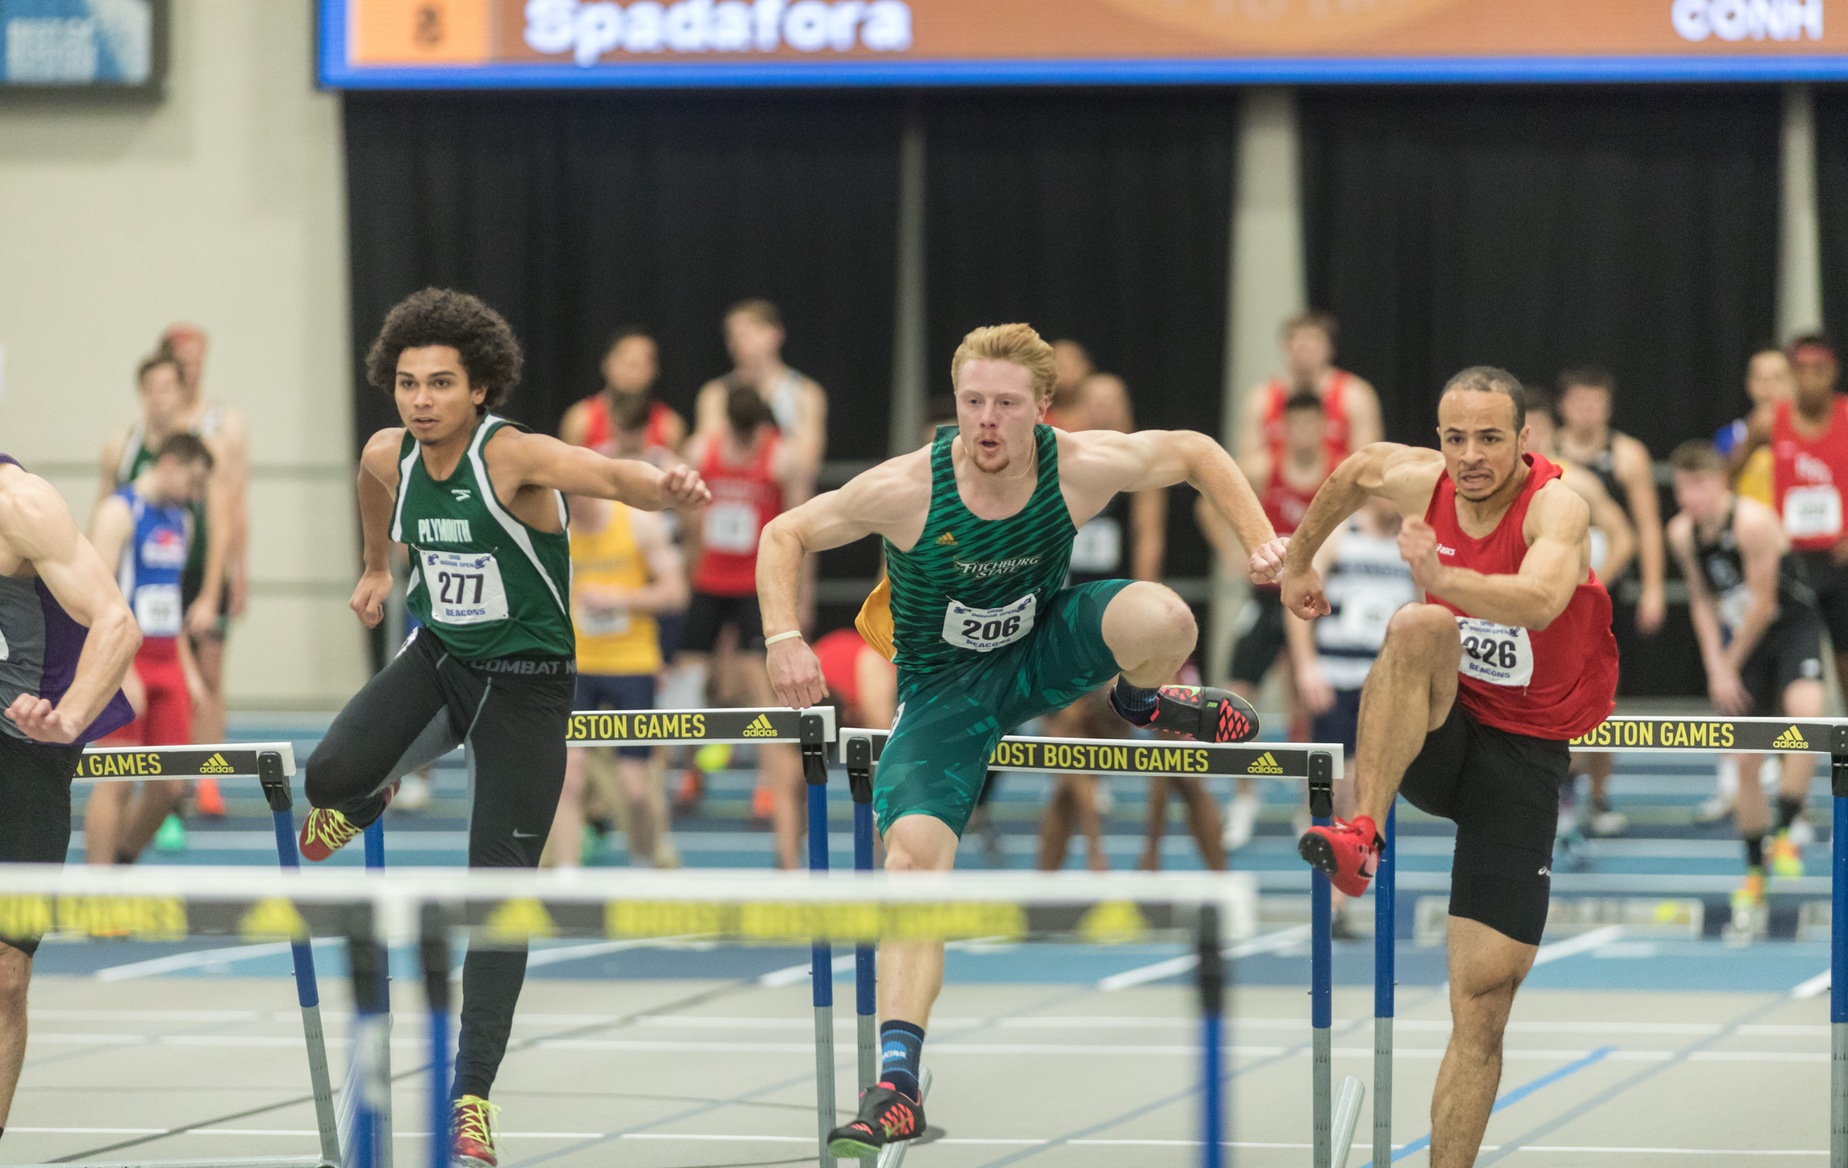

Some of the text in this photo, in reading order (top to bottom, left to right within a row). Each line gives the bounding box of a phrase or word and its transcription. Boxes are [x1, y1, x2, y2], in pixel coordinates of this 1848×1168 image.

[524, 0, 912, 66] Spadafora
[418, 519, 472, 542] PLYMOUTH
[956, 556, 1040, 574] FITCHBURG
[438, 571, 484, 604] 277
[446, 608, 486, 617] BEACONS
[962, 616, 1021, 640] 206
[470, 660, 560, 674] COMBAT
[1469, 662, 1511, 678] BEACONS
[565, 714, 706, 739] STON GAMES
[743, 728, 778, 737] adidas
[1569, 721, 1734, 747] OSTON GAMES
[1773, 740, 1809, 749] adidas
[89, 754, 162, 776] GAMES
[989, 742, 1209, 772] OST BOSTON GAMES
[200, 765, 235, 774] adidas
[1247, 765, 1284, 774] adidas
